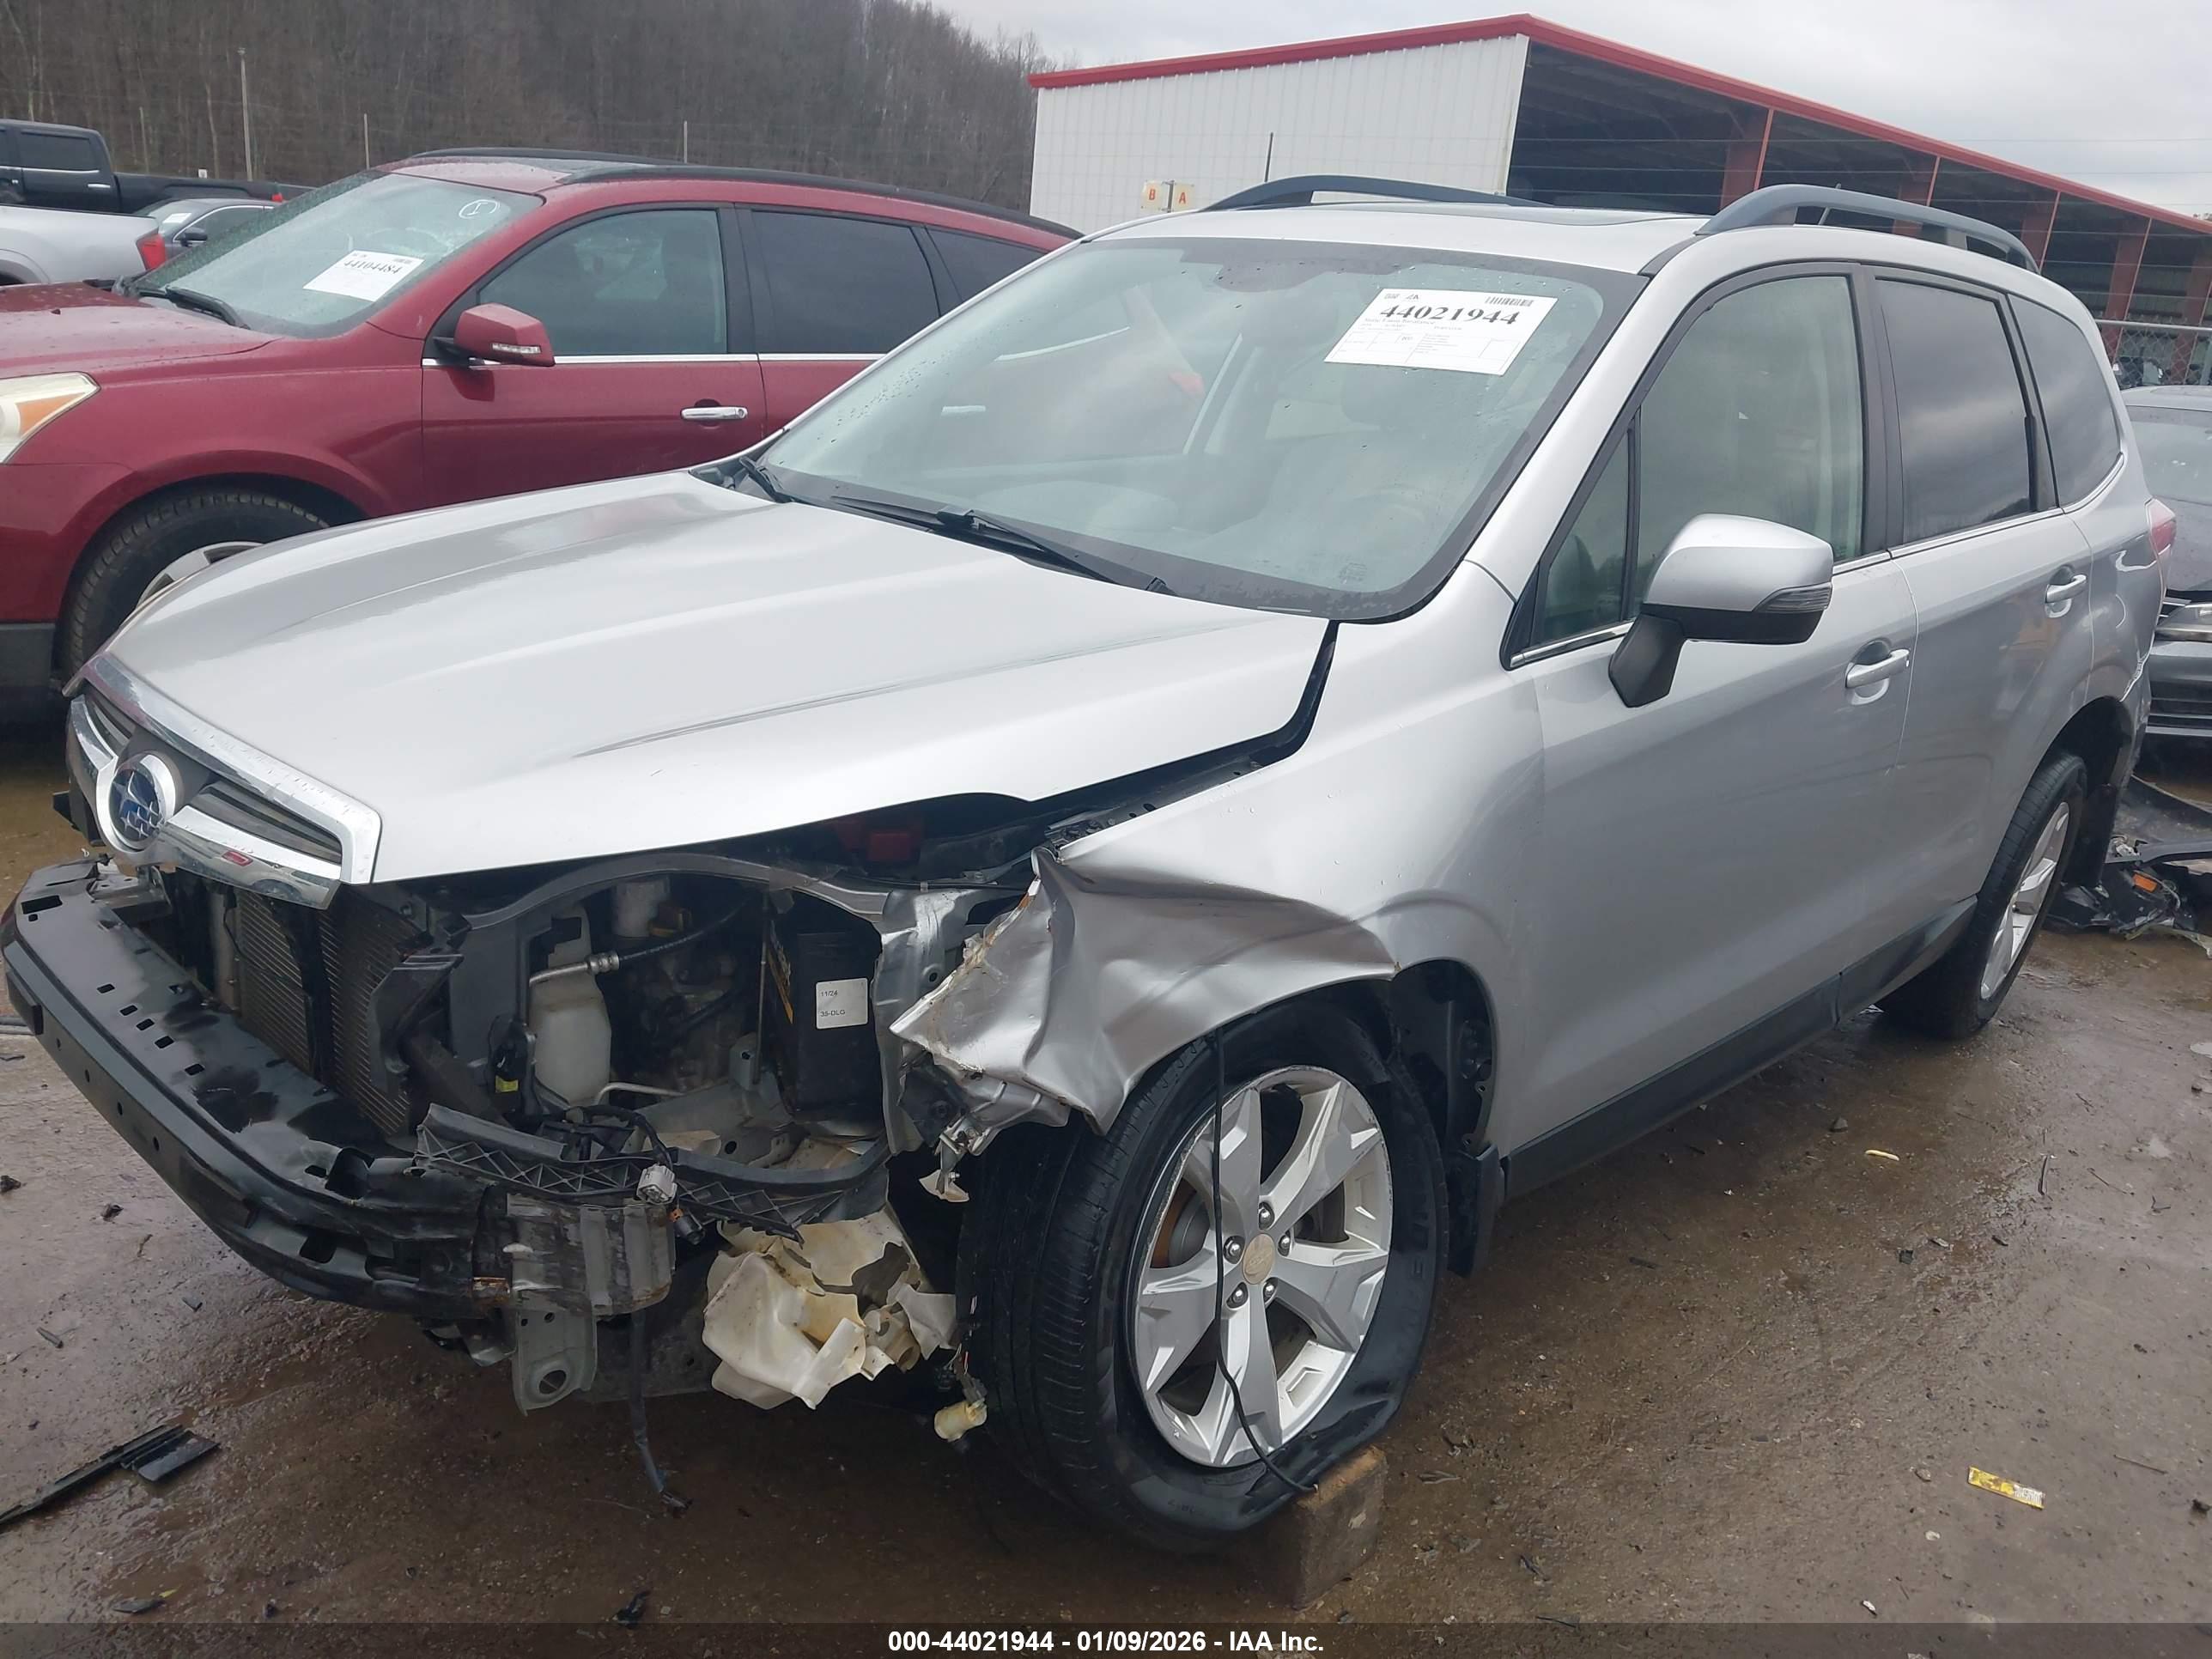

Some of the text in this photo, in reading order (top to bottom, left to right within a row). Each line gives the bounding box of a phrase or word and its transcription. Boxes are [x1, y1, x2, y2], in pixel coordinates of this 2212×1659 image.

[1148, 188, 1156, 201] B
[1178, 191, 1186, 204] A
[1380, 304, 1520, 325] 44021944
